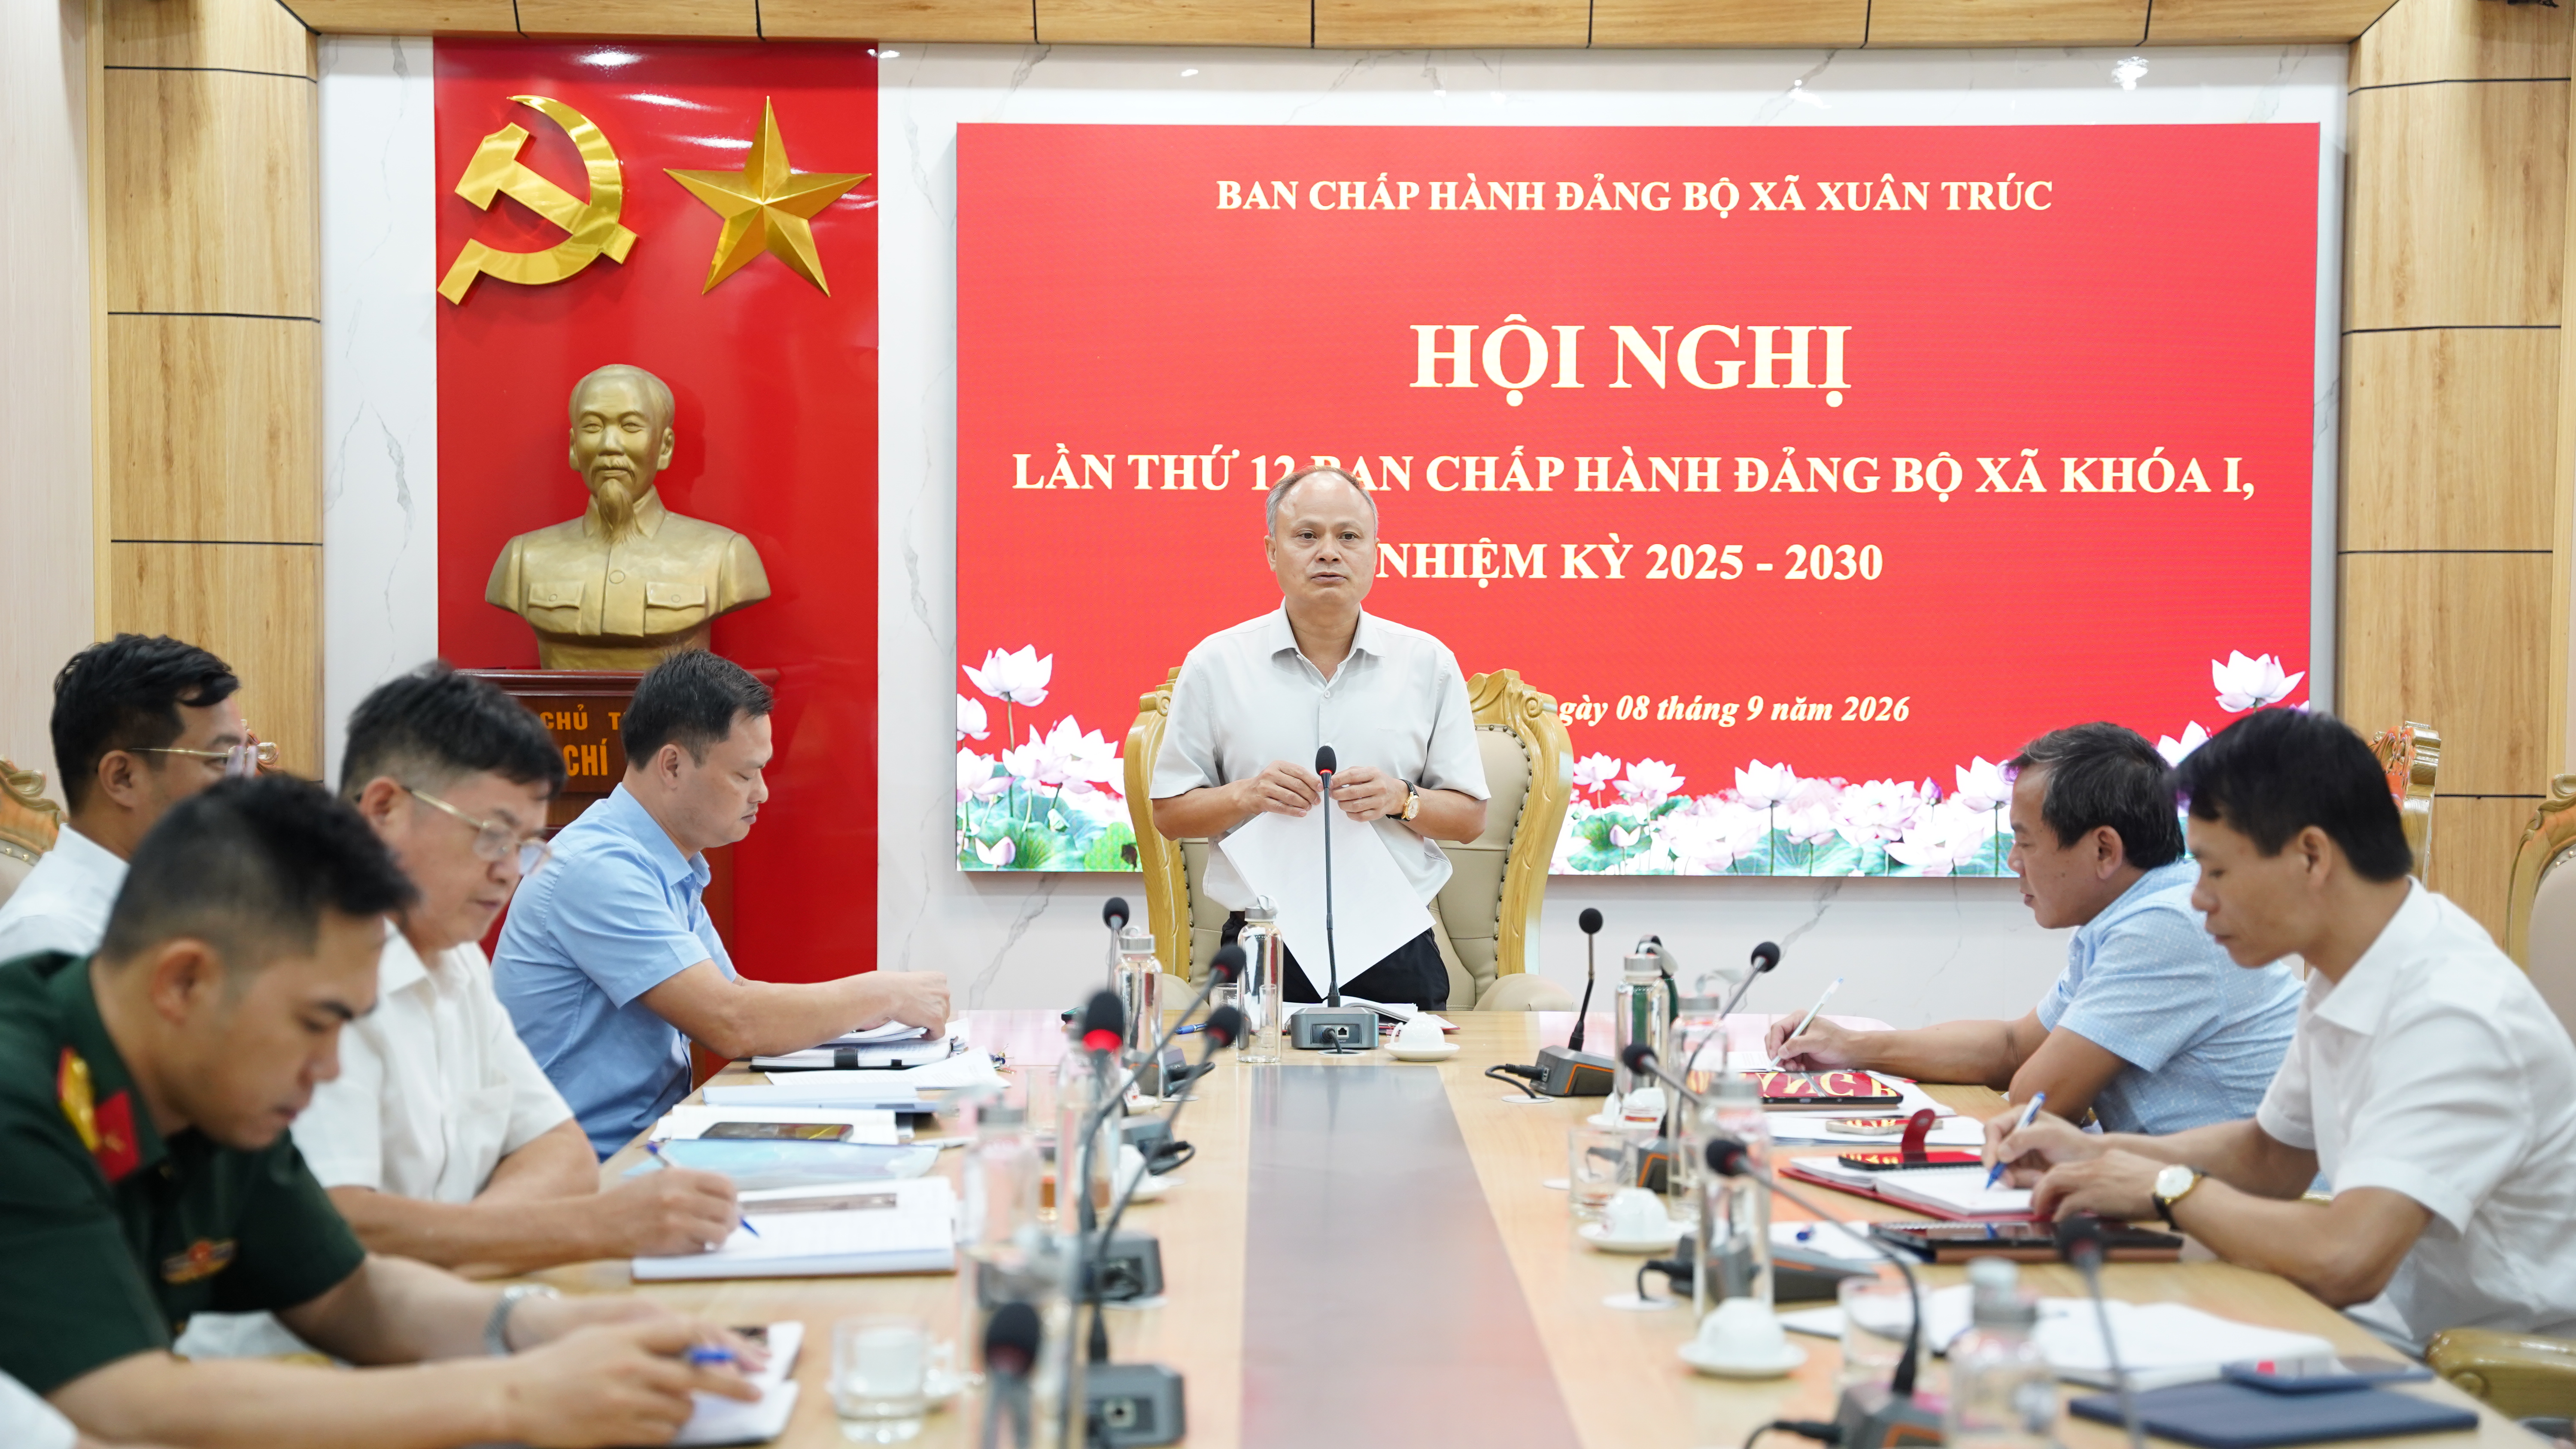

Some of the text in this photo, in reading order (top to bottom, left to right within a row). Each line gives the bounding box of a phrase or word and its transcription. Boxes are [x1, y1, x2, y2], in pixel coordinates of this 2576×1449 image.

[1216, 172, 2052, 219] BAN CHẤP HÀNH ĐẢNG BỘ XÃ XUÂN TRÚC
[1409, 314, 1852, 407] HỘI NGHỊ
[1012, 443, 1116, 490] LẦN
[1127, 444, 1240, 491] THỨ
[1426, 445, 1564, 491] CHẤP
[1574, 446, 1722, 492] HÀNH
[1734, 446, 1881, 493] ĐẢNG
[1891, 452, 1962, 503] BỘ
[1975, 448, 2047, 493] XÃ
[2060, 446, 2211, 493] KHÓA
[2223, 457, 2254, 500] I,
[1375, 535, 1548, 588] NHIỆM
[1560, 532, 1634, 579] KỲ
[1646, 543, 1743, 580] 2025
[1784, 544, 1883, 580] 2030
[540, 704, 588, 731] CHỦ
[1559, 694, 1911, 728] gày 08 tháng 9 năm 2026
[563, 738, 608, 777] CHÍ
